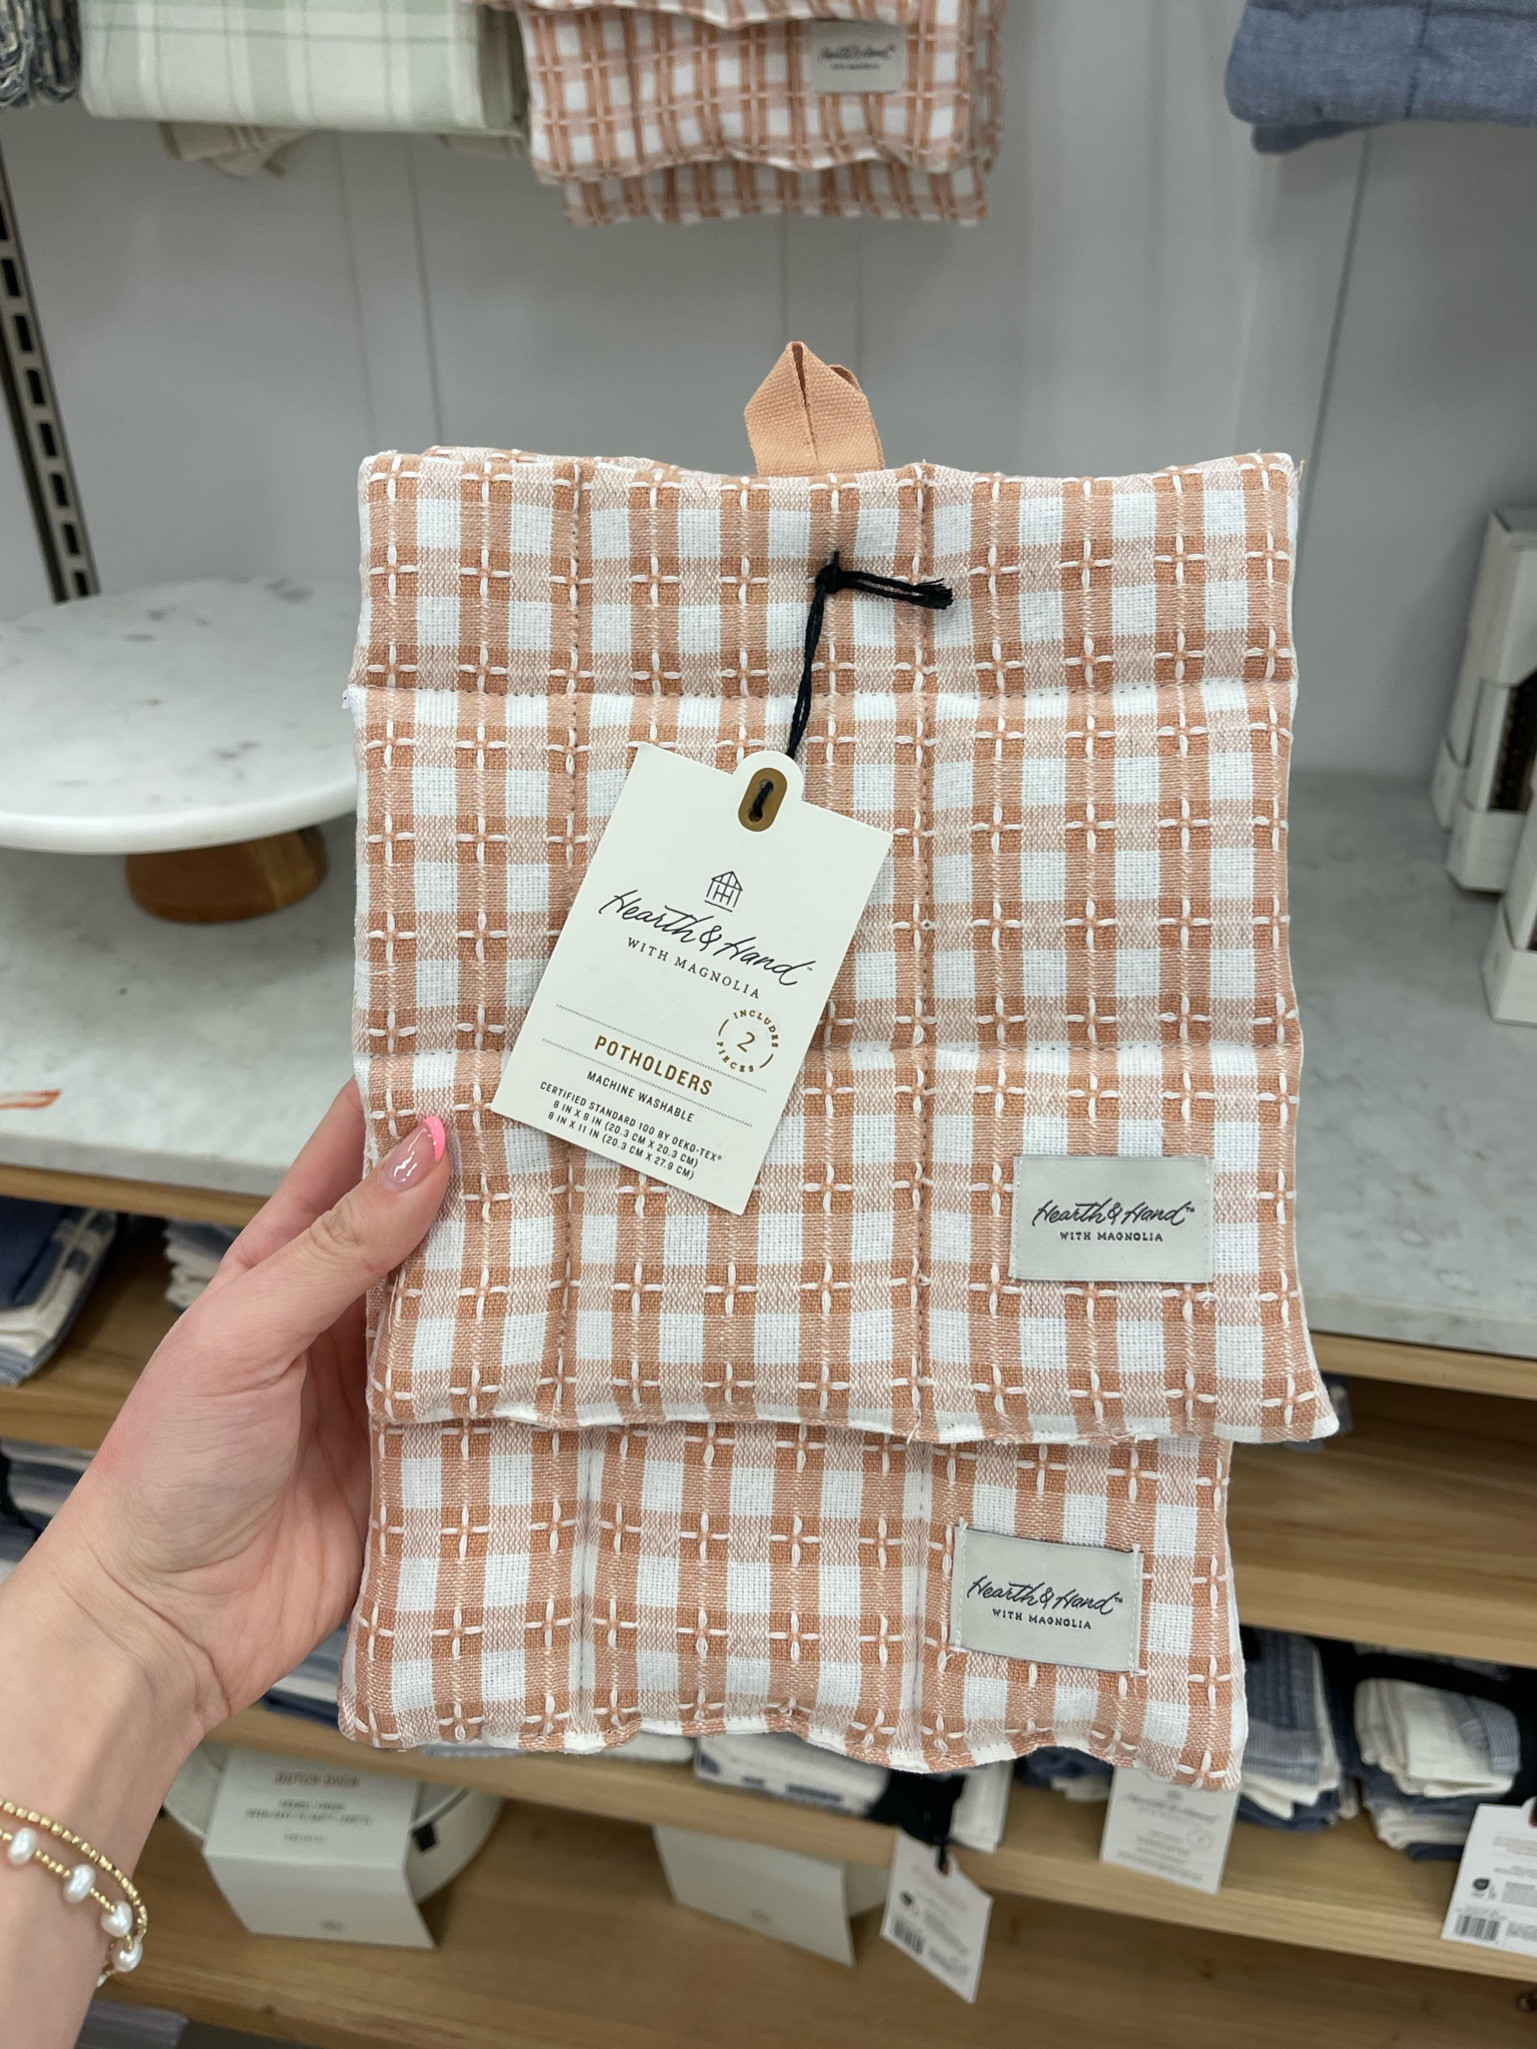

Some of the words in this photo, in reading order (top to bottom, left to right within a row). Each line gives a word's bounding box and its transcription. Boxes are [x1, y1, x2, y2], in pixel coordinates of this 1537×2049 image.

[599, 889, 714, 943] Hearth
[699, 925, 722, 952] &
[627, 937, 669, 961] WITH
[674, 957, 760, 999] MAGNOLIA
[733, 1009, 779, 1048] INCLUDES
[737, 1031, 755, 1052] 2
[594, 1035, 713, 1096] POTHOLDERS
[716, 1041, 754, 1072] PIECES
[540, 1081, 587, 1107] CERTIFIED
[588, 1101, 636, 1127] STANDARD
[638, 1122, 656, 1135] 100
[657, 1130, 670, 1141] BY
[586, 1071, 635, 1098] MACHINE
[638, 1092, 695, 1123] WASHABLE
[547, 1111, 555, 1120] 8
[556, 1115, 568, 1125] IN
[568, 1121, 576, 1129] X
[578, 1124, 587, 1133] 11
[589, 1128, 600, 1139] IN
[602, 1133, 627, 1151] (20.3
[629, 1145, 644, 1158] CM
[645, 1152, 653, 1161] X
[654, 1156, 674, 1171] 27.9
[675, 1165, 695, 1181] CM)
[553, 1100, 560, 1109] 8
[561, 1103, 573, 1114] IN
[574, 1109, 582, 1118] X
[583, 1112, 590, 1121] 8
[591, 1116, 603, 1126] IN
[604, 1121, 630, 1138] (20.3
[631, 1132, 646, 1145] CM
[647, 1140, 655, 1149] X
[656, 1143, 678, 1159] 20.3
[679, 1153, 699, 1169] CM)
[1032, 1197, 1113, 1227] Hearth
[1107, 1202, 1123, 1226] &
[1059, 1231, 1091, 1241] WITH
[1097, 1232, 1164, 1242] MAGNOLIA
[967, 1575, 1045, 1607] Hearth
[1039, 1587, 1054, 1609] &
[992, 1608, 1023, 1621] WITH
[1028, 1614, 1092, 1630] MAGNOLIA
